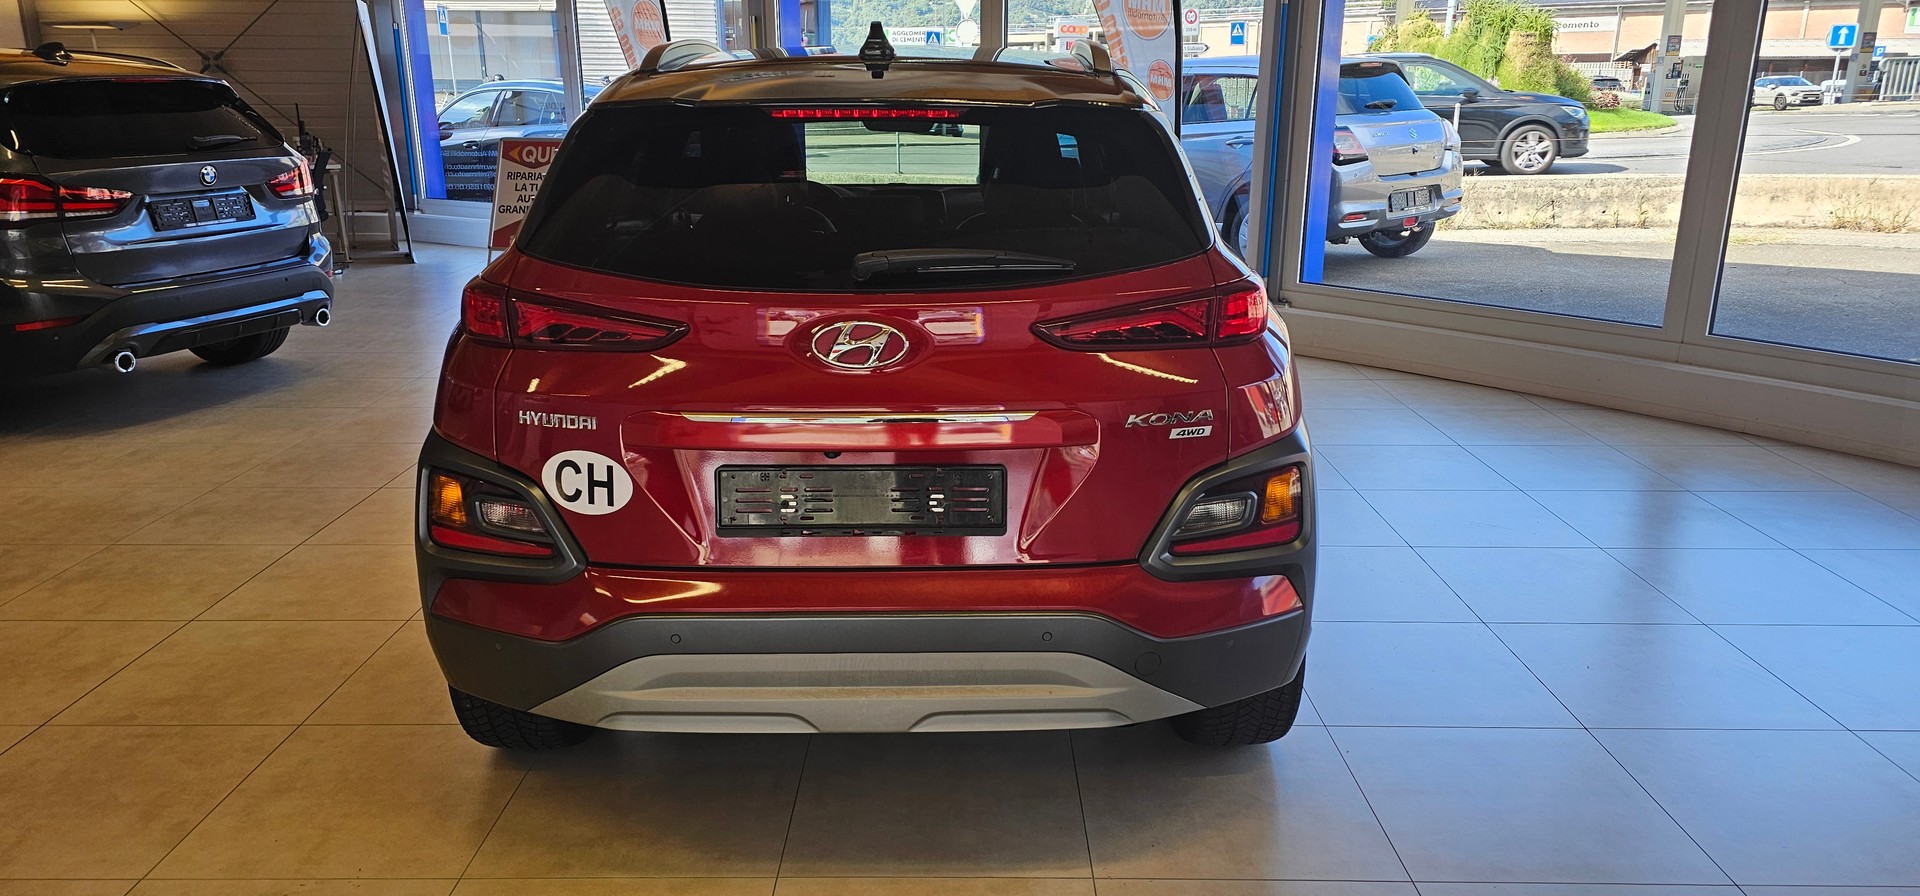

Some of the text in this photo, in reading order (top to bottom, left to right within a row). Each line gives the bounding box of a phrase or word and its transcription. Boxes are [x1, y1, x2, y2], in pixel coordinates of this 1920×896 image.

[1060, 25, 1088, 35] coop
[1876, 47, 1884, 56] P
[507, 172, 545, 180] RIPARIA
[514, 183, 527, 191] LA
[498, 205, 530, 214] GRAN
[519, 410, 597, 430] HYUNDAI
[1125, 409, 1214, 428] KONA
[1175, 428, 1205, 436] 4WD
[555, 459, 614, 507] CH
